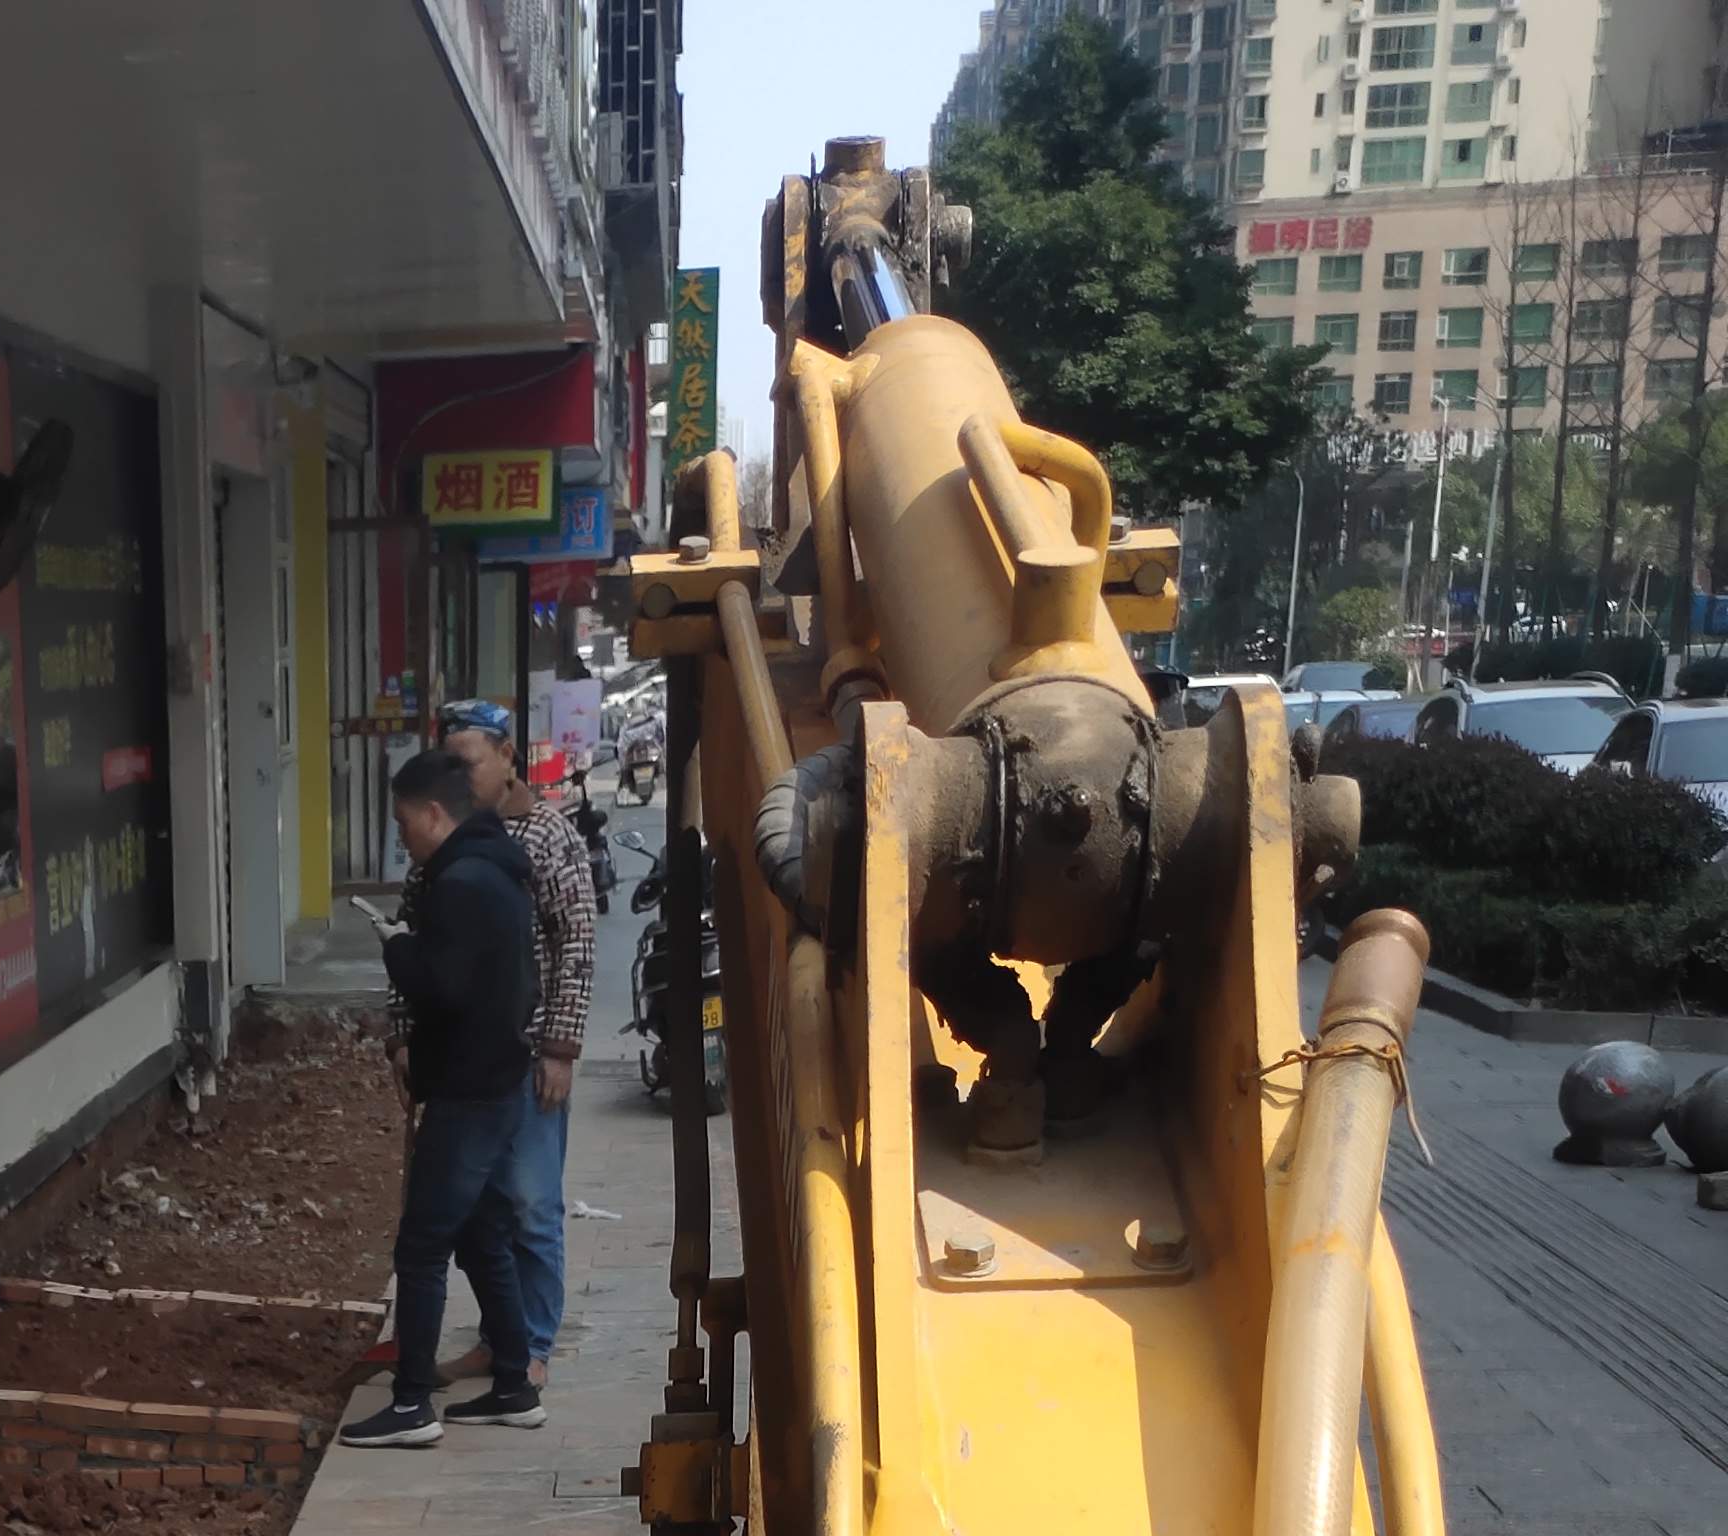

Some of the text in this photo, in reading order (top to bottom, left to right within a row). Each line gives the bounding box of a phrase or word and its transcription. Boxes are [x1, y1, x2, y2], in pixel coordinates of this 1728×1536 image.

[671, 270, 713, 486] 天然居茶
[434, 460, 540, 513] 烟酒
